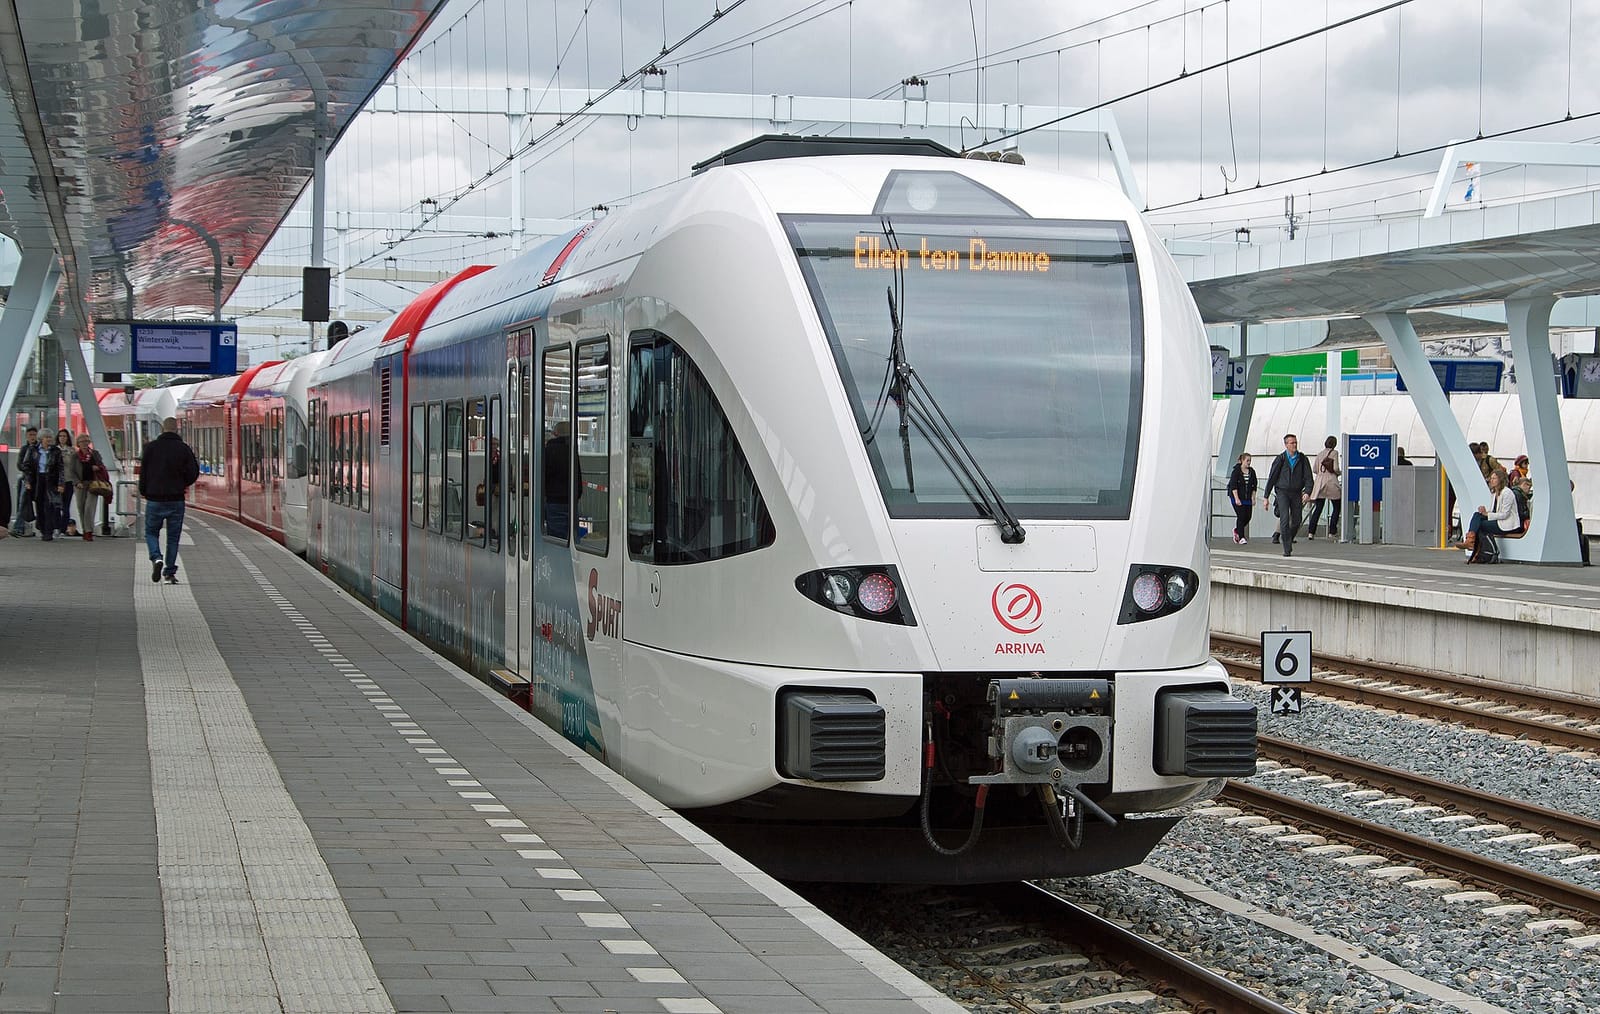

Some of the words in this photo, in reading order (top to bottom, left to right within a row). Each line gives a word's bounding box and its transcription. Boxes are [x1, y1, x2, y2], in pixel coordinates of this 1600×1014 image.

[854, 236, 909, 269] Ellen
[919, 236, 960, 271] ten
[969, 238, 1050, 272] Damme
[138, 335, 180, 344] Winterswijk
[994, 642, 1046, 655] ARRIVA
[1274, 638, 1299, 677] 6
